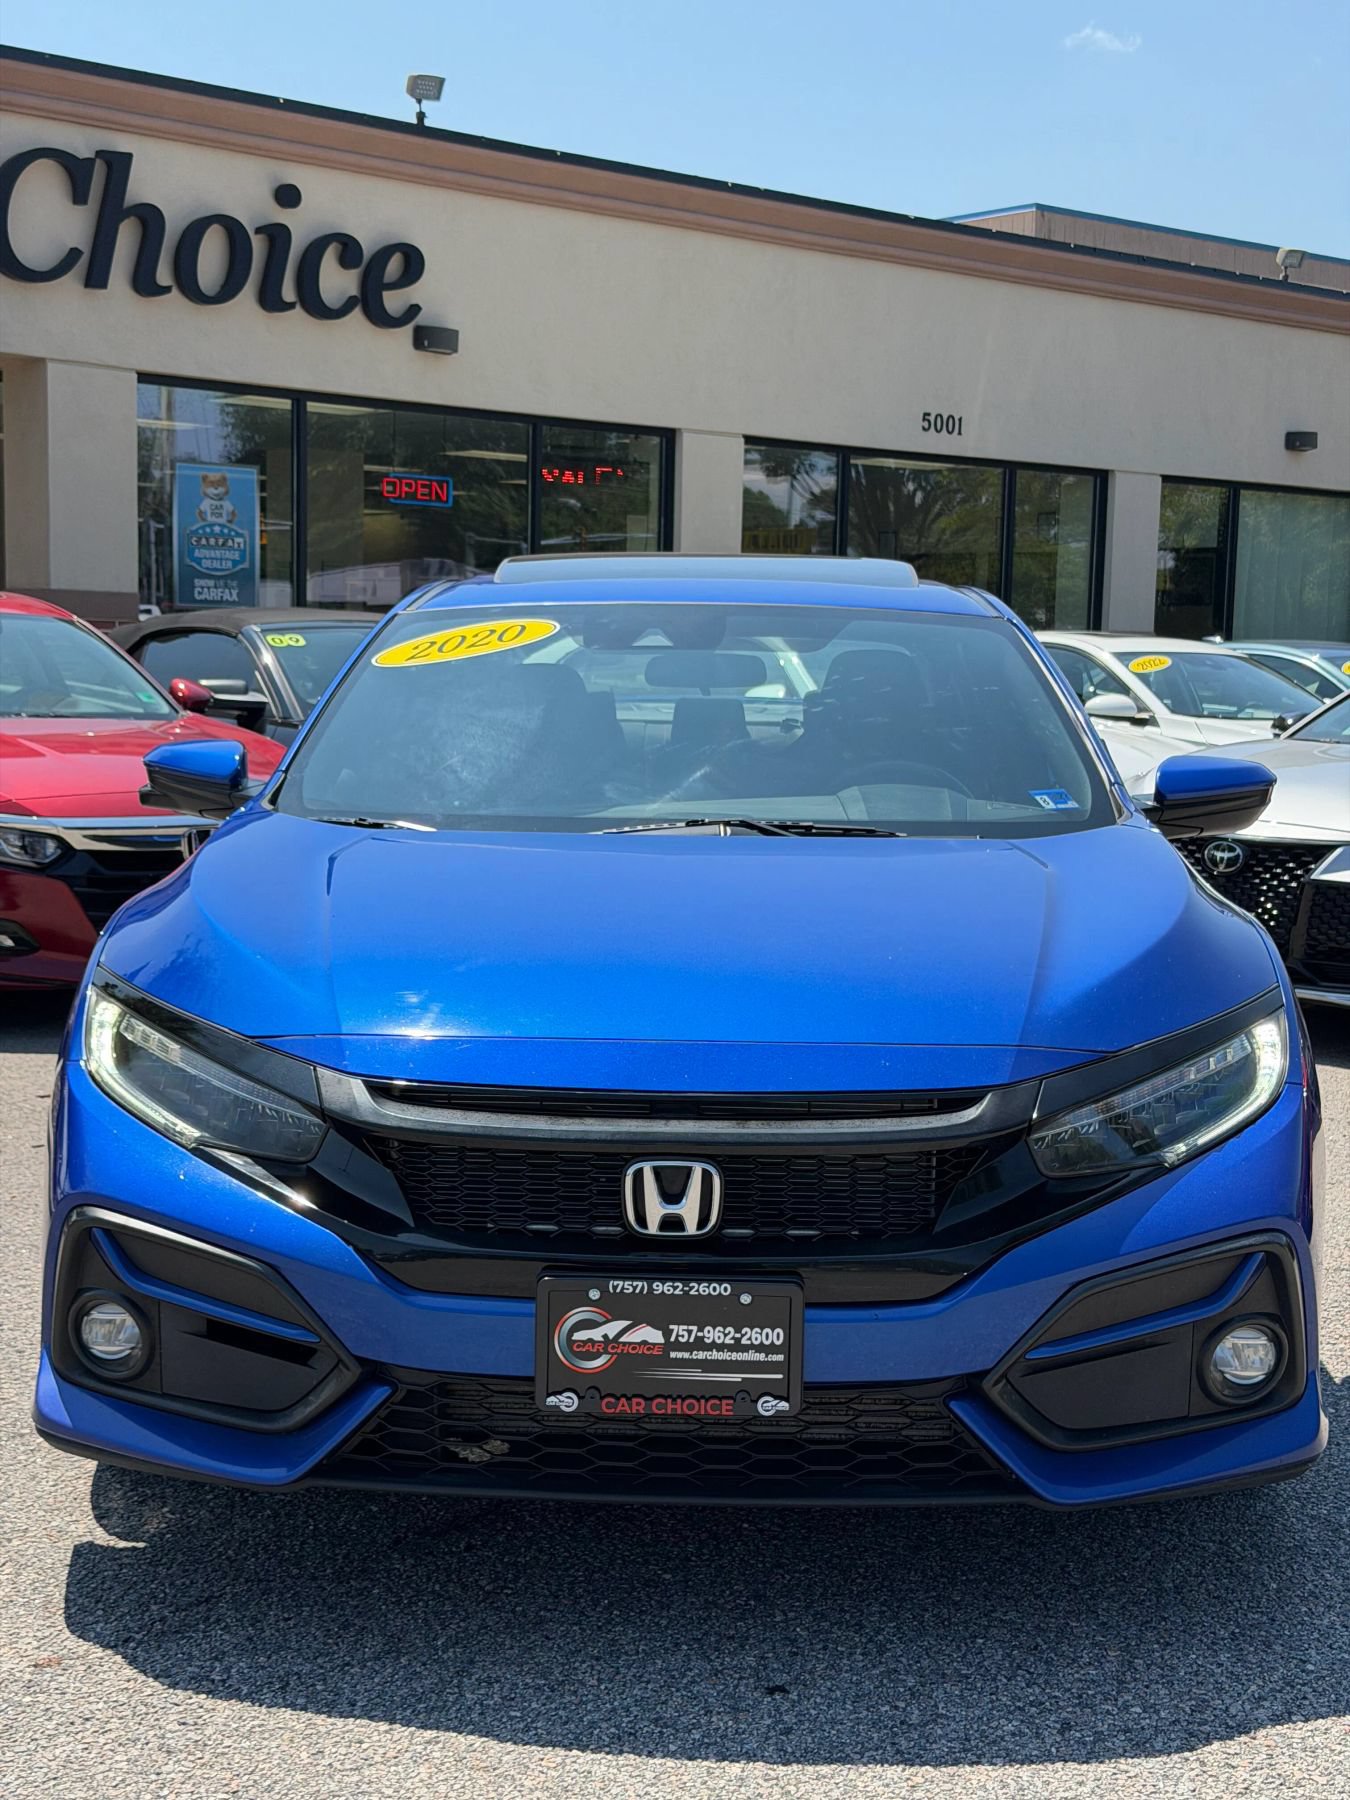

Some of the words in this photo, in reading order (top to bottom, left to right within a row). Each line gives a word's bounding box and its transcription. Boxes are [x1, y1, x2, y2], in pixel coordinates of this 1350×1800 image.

[0, 147, 425, 329] Choice
[921, 411, 963, 436] 5001
[381, 476, 448, 502] OPEN
[209, 503, 224, 511] CAR
[190, 536, 244, 549] CARFAX
[193, 549, 240, 560] ADVANTAGE
[201, 560, 233, 569] DEALER
[193, 579, 215, 588] SHOW
[193, 588, 239, 602] CARFAX
[270, 635, 301, 646] 09
[405, 624, 527, 662] 2020
[608, 1279, 648, 1295] (757)
[652, 1281, 732, 1296] 962-2600
[668, 1324, 784, 1345] 757-962-2600
[572, 1342, 605, 1352] CAR
[607, 1343, 665, 1355] CHOICE
[669, 1350, 784, 1362] www.carchoiceonline.com
[601, 1397, 645, 1415] CAR
[651, 1397, 734, 1416] CHOICE
